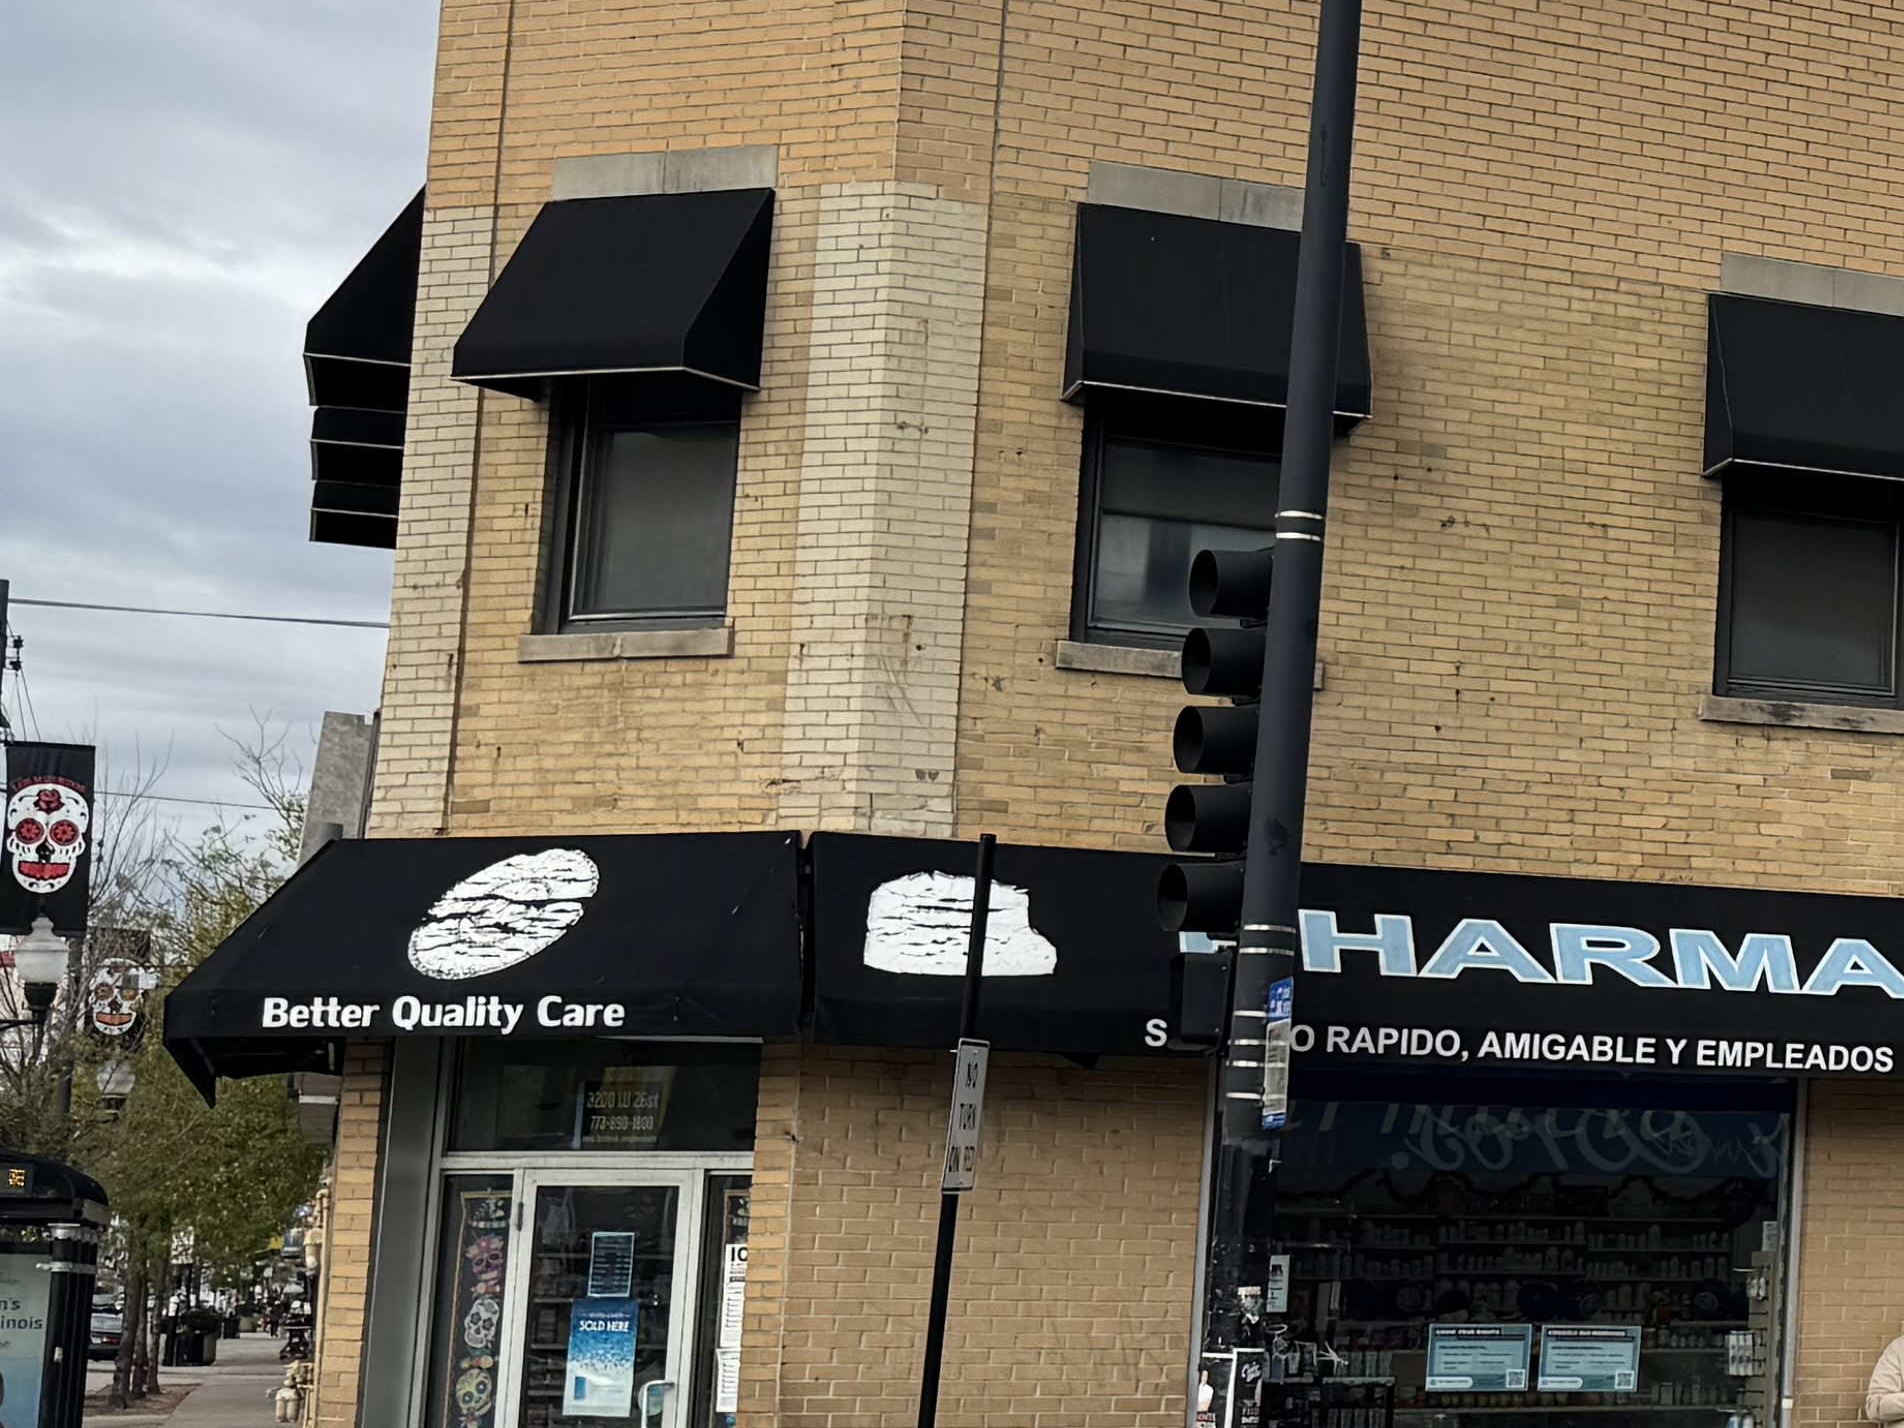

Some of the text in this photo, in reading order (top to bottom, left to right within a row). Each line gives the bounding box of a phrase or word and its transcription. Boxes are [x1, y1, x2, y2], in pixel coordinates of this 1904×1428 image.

[262, 995, 625, 1034] Better Quality Care
[1326, 1025, 1468, 1062] RAPIDO,
[1478, 1030, 1655, 1063] AMIGABLE
[1665, 1039, 1687, 1065] Y
[1696, 1040, 1893, 1073] EMPLEADOS
[579, 1320, 630, 1332] SOLD HERE
